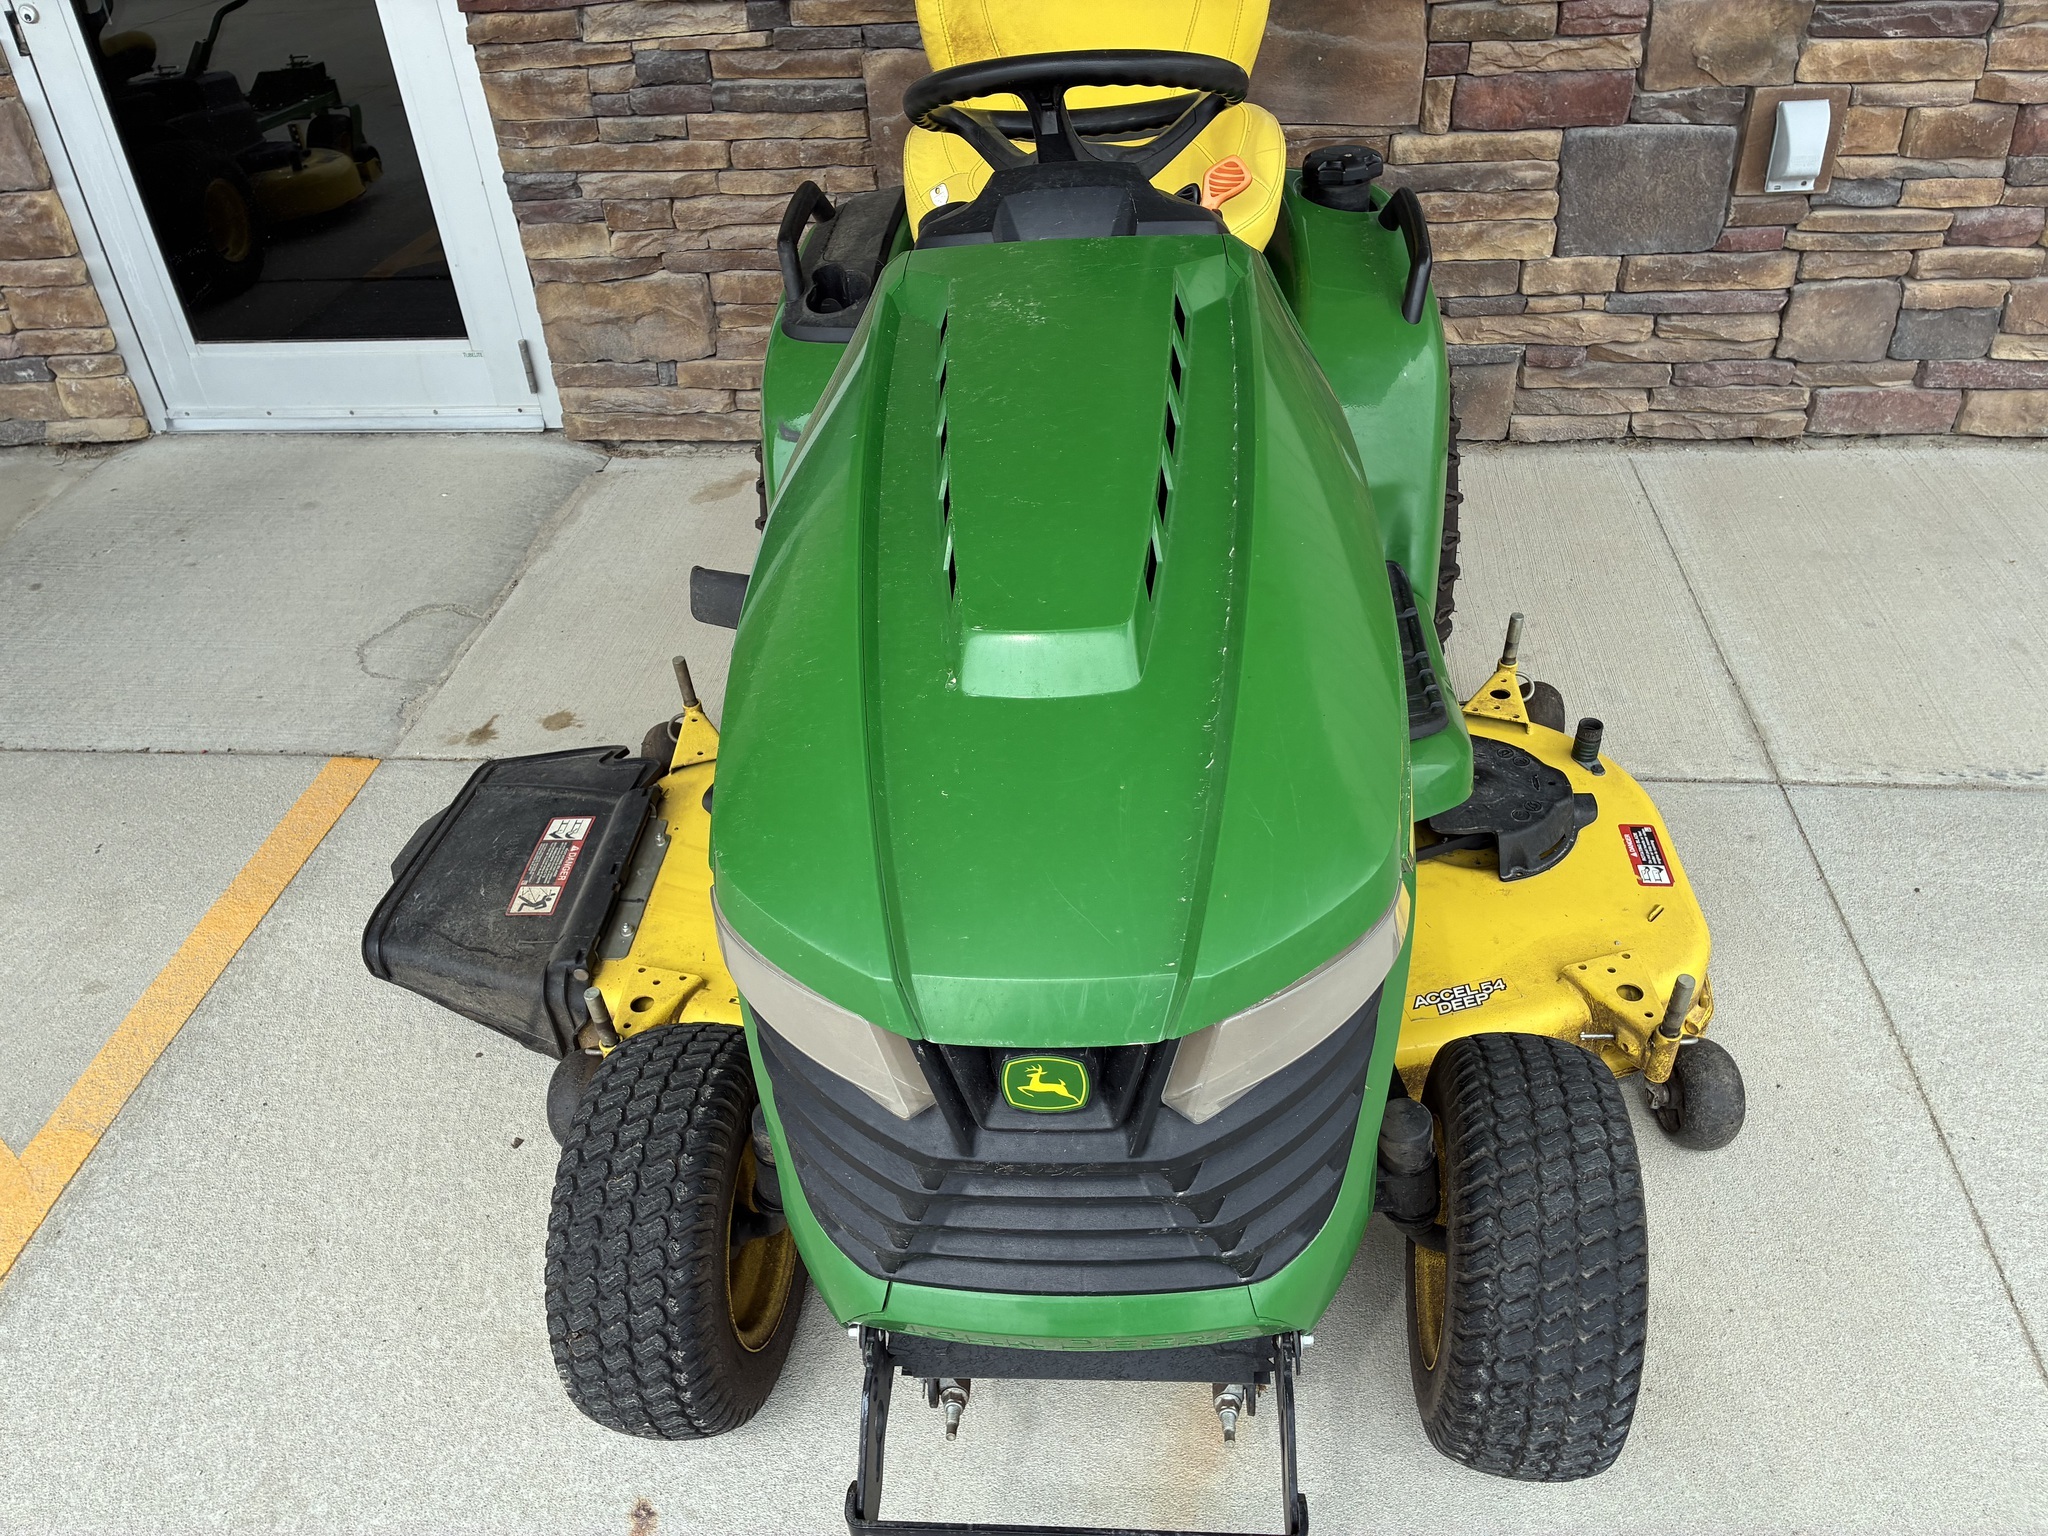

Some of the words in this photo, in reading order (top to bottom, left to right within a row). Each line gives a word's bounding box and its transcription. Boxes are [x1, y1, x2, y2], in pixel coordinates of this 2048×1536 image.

[1623, 834, 1635, 852] DANGER
[557, 852, 576, 880] DANGER
[1413, 984, 1479, 1009] ACCEL
[1479, 978, 1507, 994] 54
[1436, 993, 1491, 1015] DEEP
